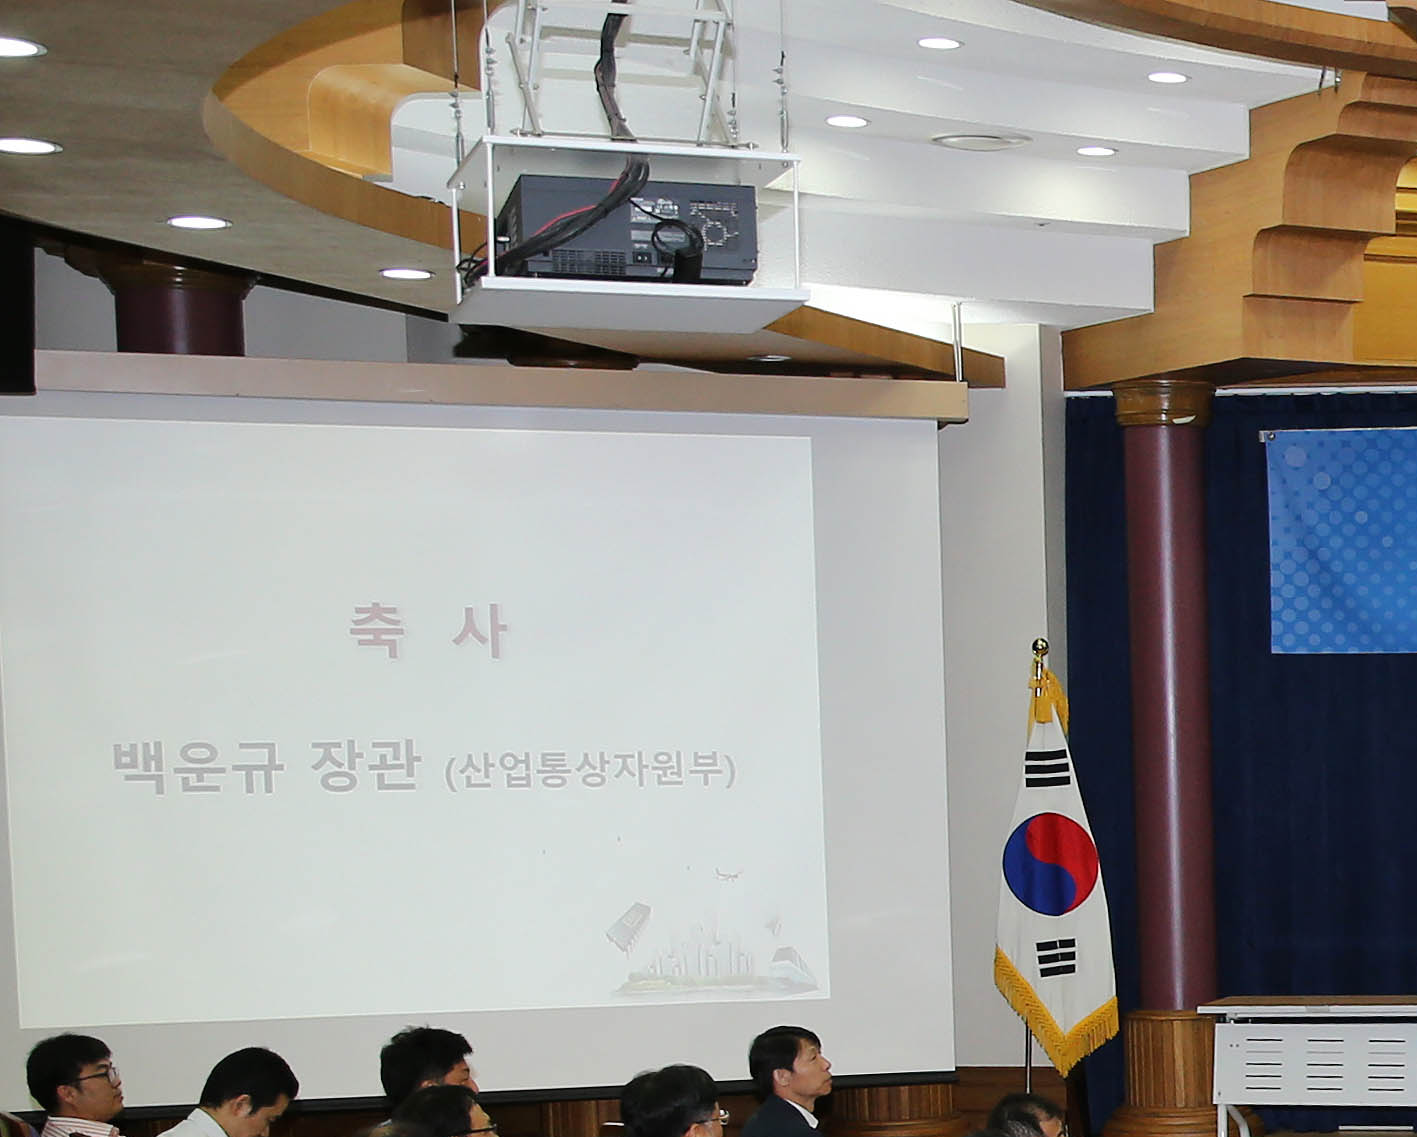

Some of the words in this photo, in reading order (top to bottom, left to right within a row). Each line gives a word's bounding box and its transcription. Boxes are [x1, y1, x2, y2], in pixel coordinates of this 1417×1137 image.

[113, 740, 286, 796] 백운규
[310, 738, 423, 794] 장관
[444, 749, 738, 793] (산업통상자원부)
